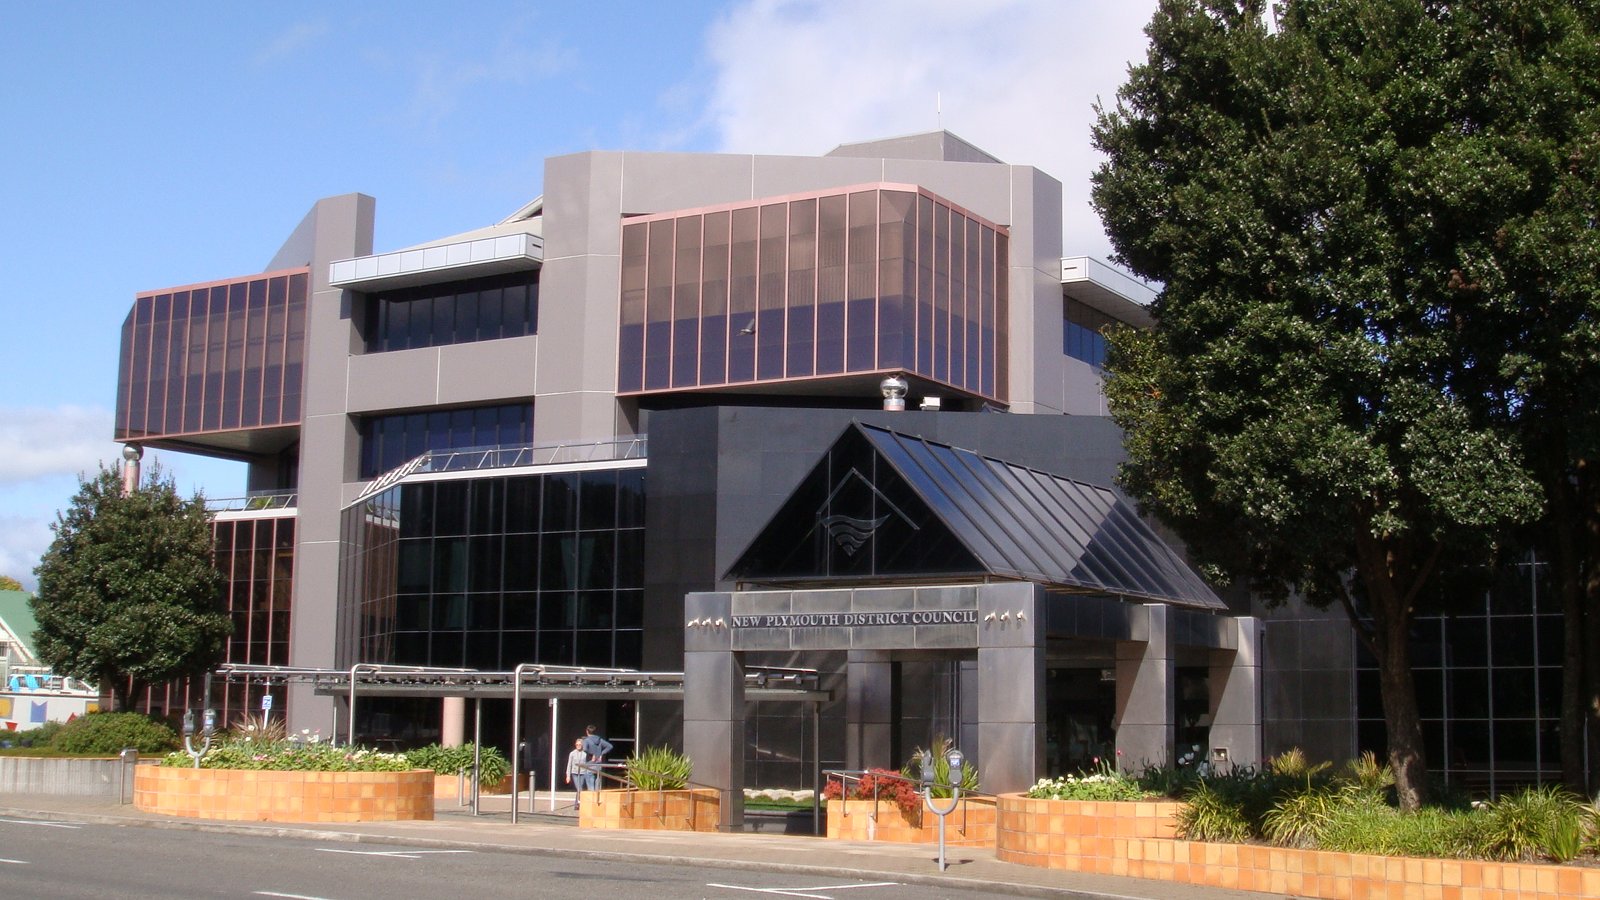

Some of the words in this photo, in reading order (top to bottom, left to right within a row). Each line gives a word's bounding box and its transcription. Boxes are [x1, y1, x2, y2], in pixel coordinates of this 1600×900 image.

[732, 616, 761, 627] NEW
[766, 614, 839, 627] PLYMOUTH
[844, 612, 909, 625] DISTRICT
[912, 611, 977, 623] COUNCIL
